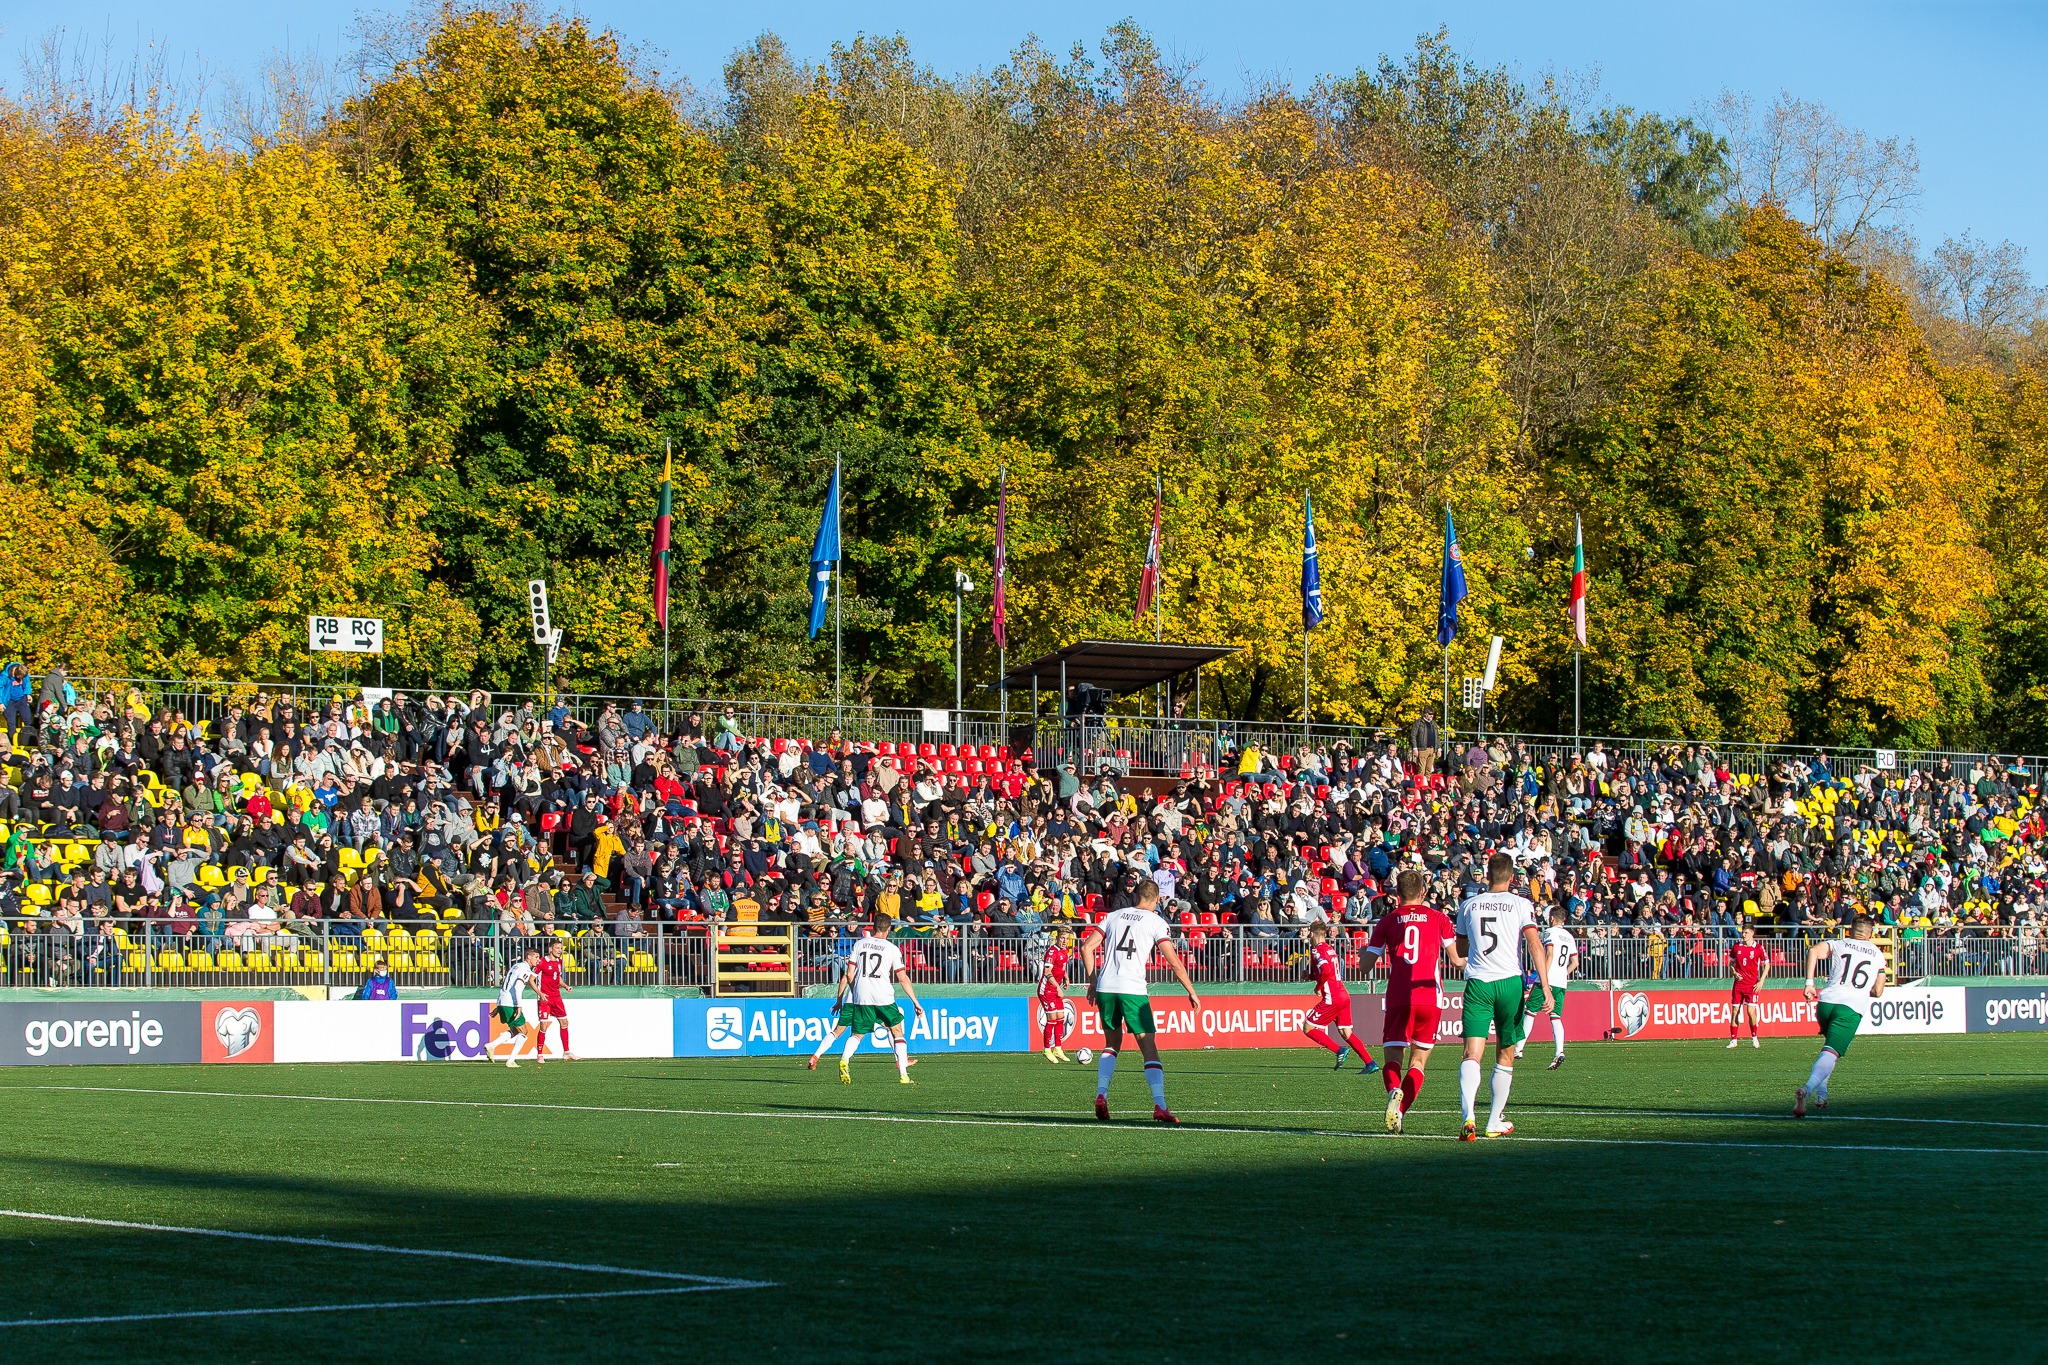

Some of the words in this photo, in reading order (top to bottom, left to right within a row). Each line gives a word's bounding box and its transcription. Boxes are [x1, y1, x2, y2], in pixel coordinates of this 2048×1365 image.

[316, 618, 339, 634] RB
[352, 620, 376, 636] RC
[1878, 752, 1895, 767] RD
[1116, 925, 1137, 960] 4
[1404, 925, 1420, 965] 9
[1480, 917, 1498, 957] 5
[859, 951, 883, 979] 12
[1558, 944, 1569, 968] 8
[1840, 953, 1872, 990] 16
[1870, 994, 1944, 1027] gorenje
[1985, 992, 2048, 1026] gorenj
[25, 1010, 164, 1057] gorenje
[909, 1008, 999, 1046] Alipay
